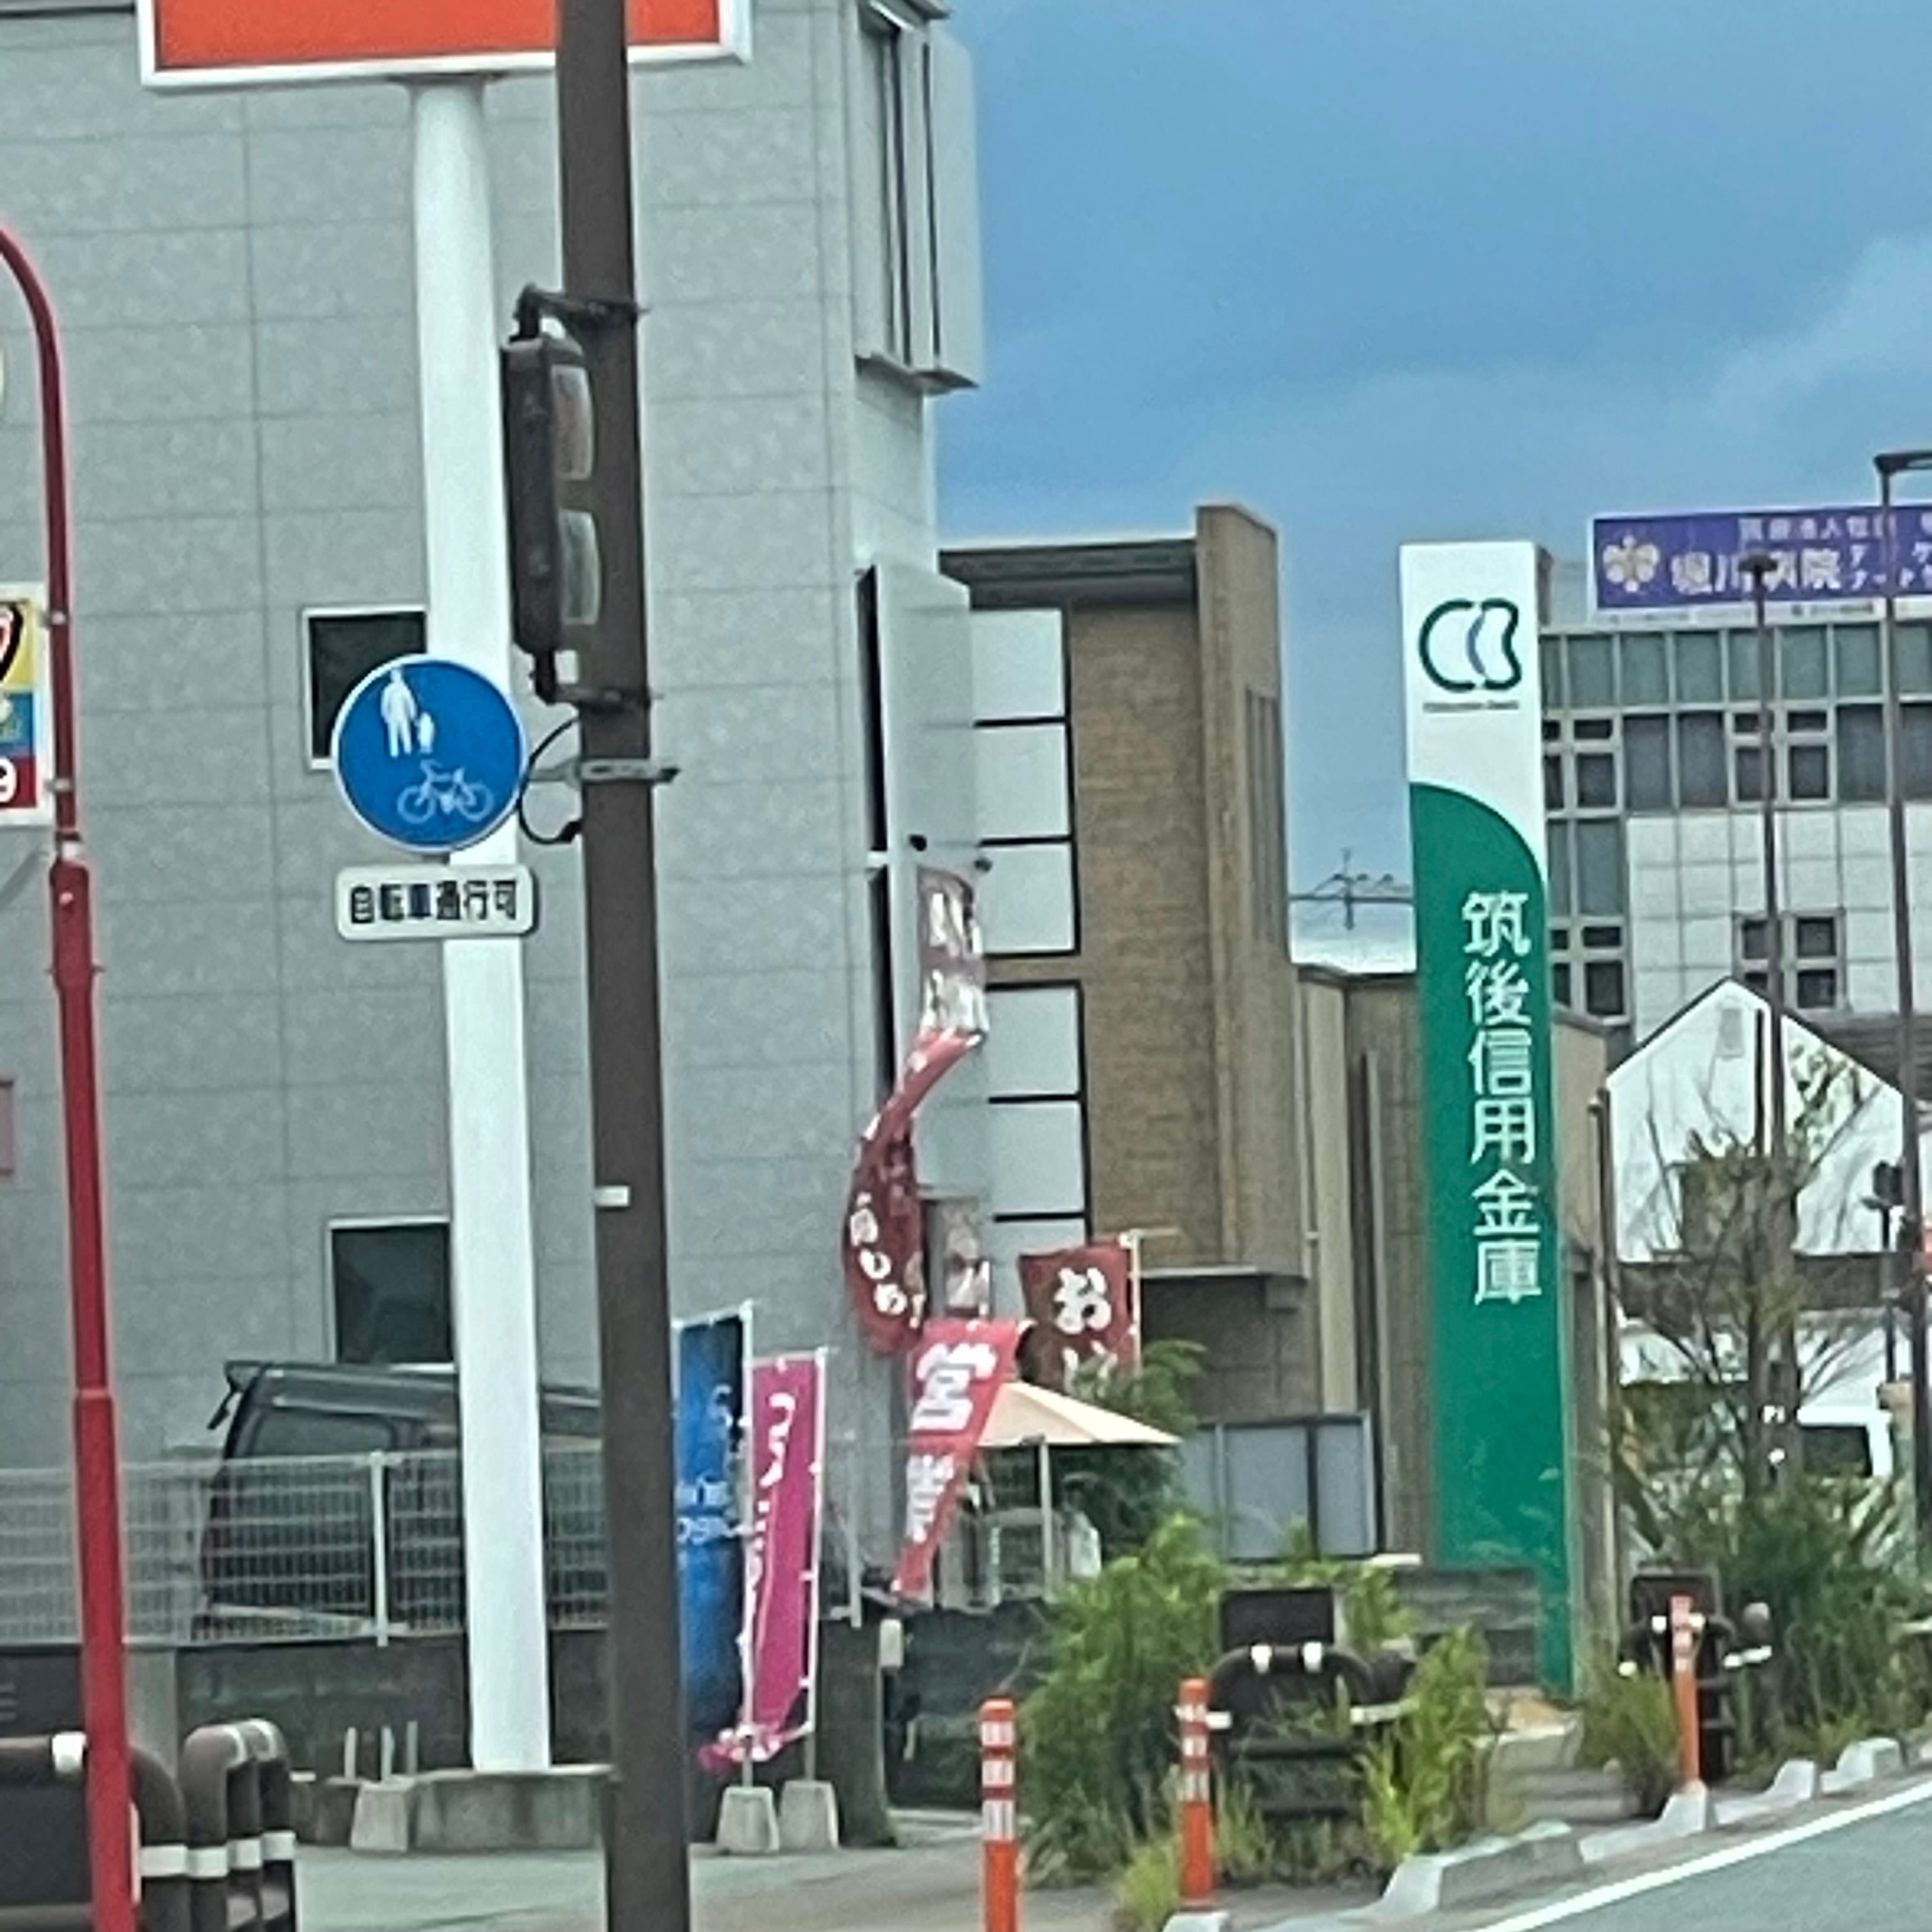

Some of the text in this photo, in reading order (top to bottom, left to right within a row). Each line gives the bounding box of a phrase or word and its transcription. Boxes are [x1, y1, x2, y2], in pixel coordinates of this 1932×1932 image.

[351, 880, 517, 924] 自転車通行可
[1462, 890, 1542, 1305] 筑後信用金庫
